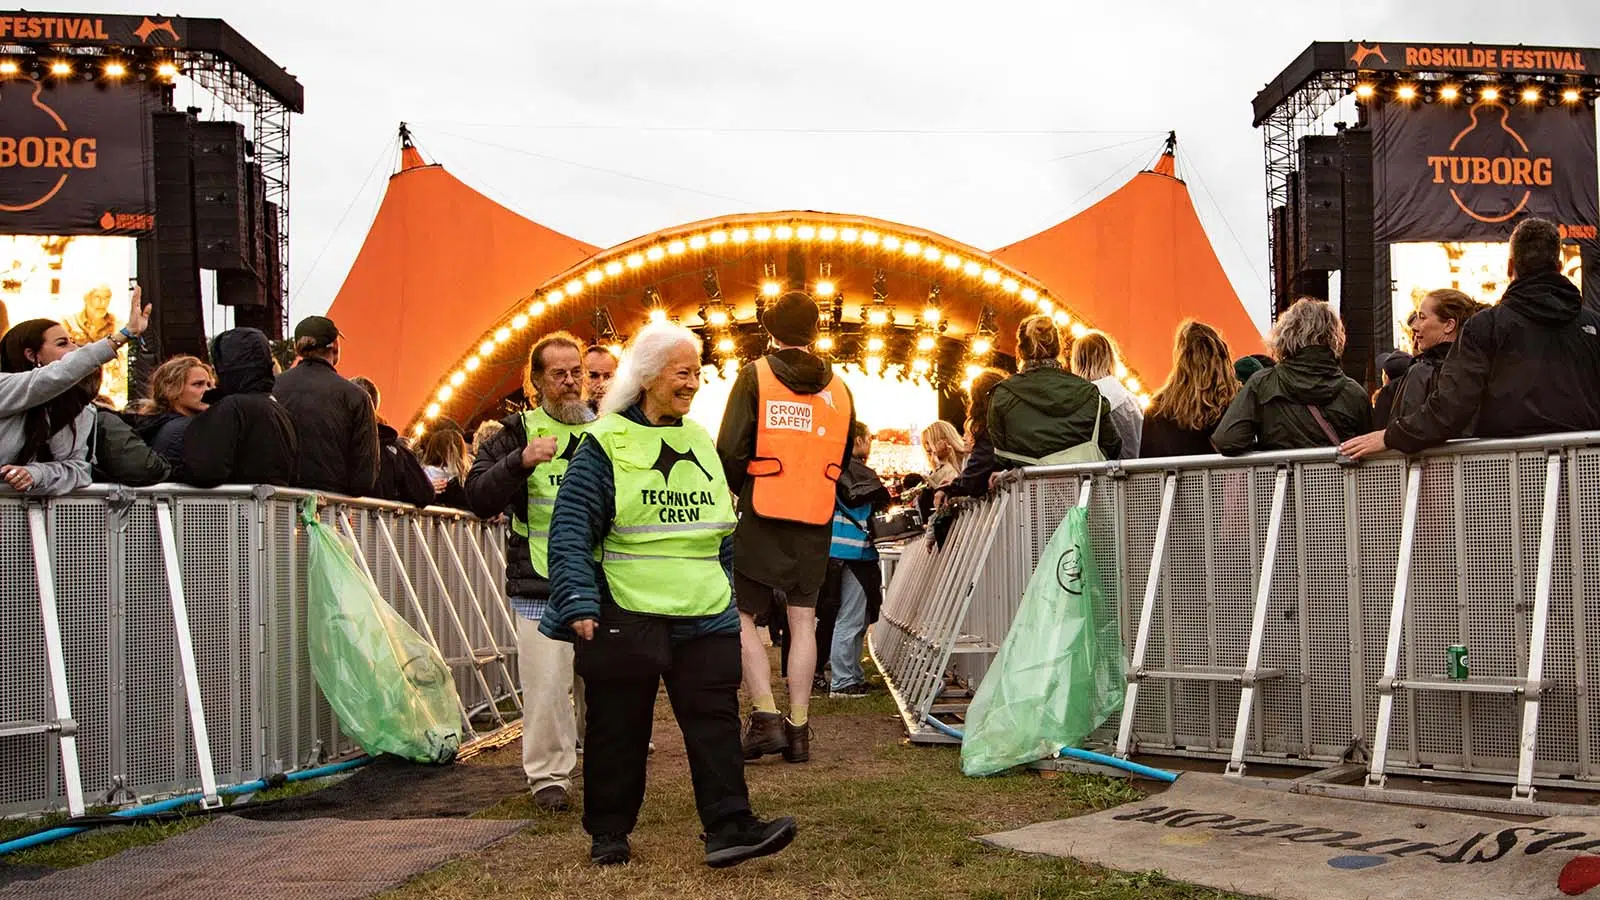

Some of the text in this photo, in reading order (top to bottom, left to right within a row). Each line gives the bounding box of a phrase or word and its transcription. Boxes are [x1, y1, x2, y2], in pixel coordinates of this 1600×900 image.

[0, 16, 109, 40] FESTIVAL
[1405, 47, 1586, 71] ROSKILDE FESTIVAL
[0, 136, 97, 168] BORG
[1427, 156, 1552, 186] TUBORG
[769, 404, 811, 418] CROWD
[769, 416, 812, 430] SAFETY
[641, 489, 716, 507] TECHNICAL
[658, 507, 701, 523] CREW
